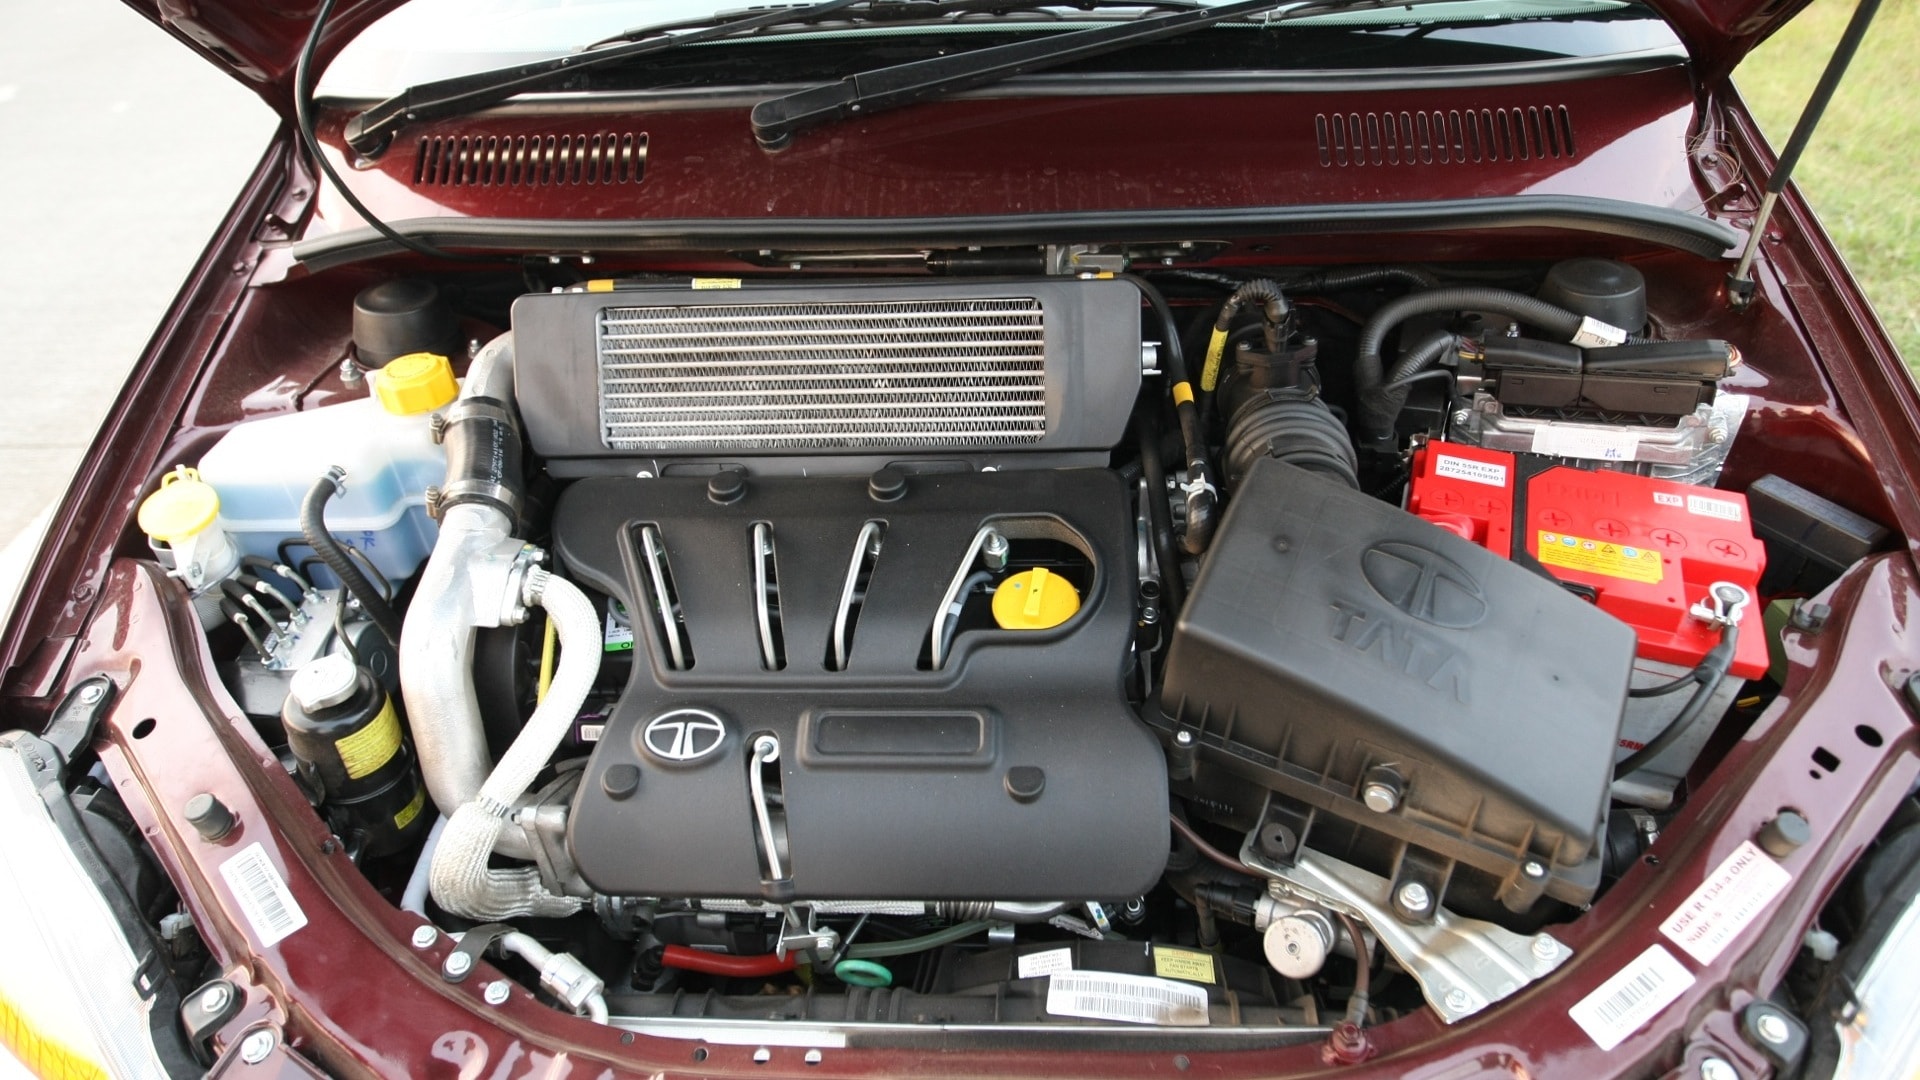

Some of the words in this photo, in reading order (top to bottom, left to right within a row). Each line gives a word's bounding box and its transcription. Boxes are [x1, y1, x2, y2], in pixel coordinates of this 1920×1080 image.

[1443, 459, 1460, 467] DIN
[1657, 493, 1679, 504] EXP
[1328, 599, 1472, 705] TATA
[1672, 911, 1697, 934] USE
[1729, 848, 1757, 876] ONLY
